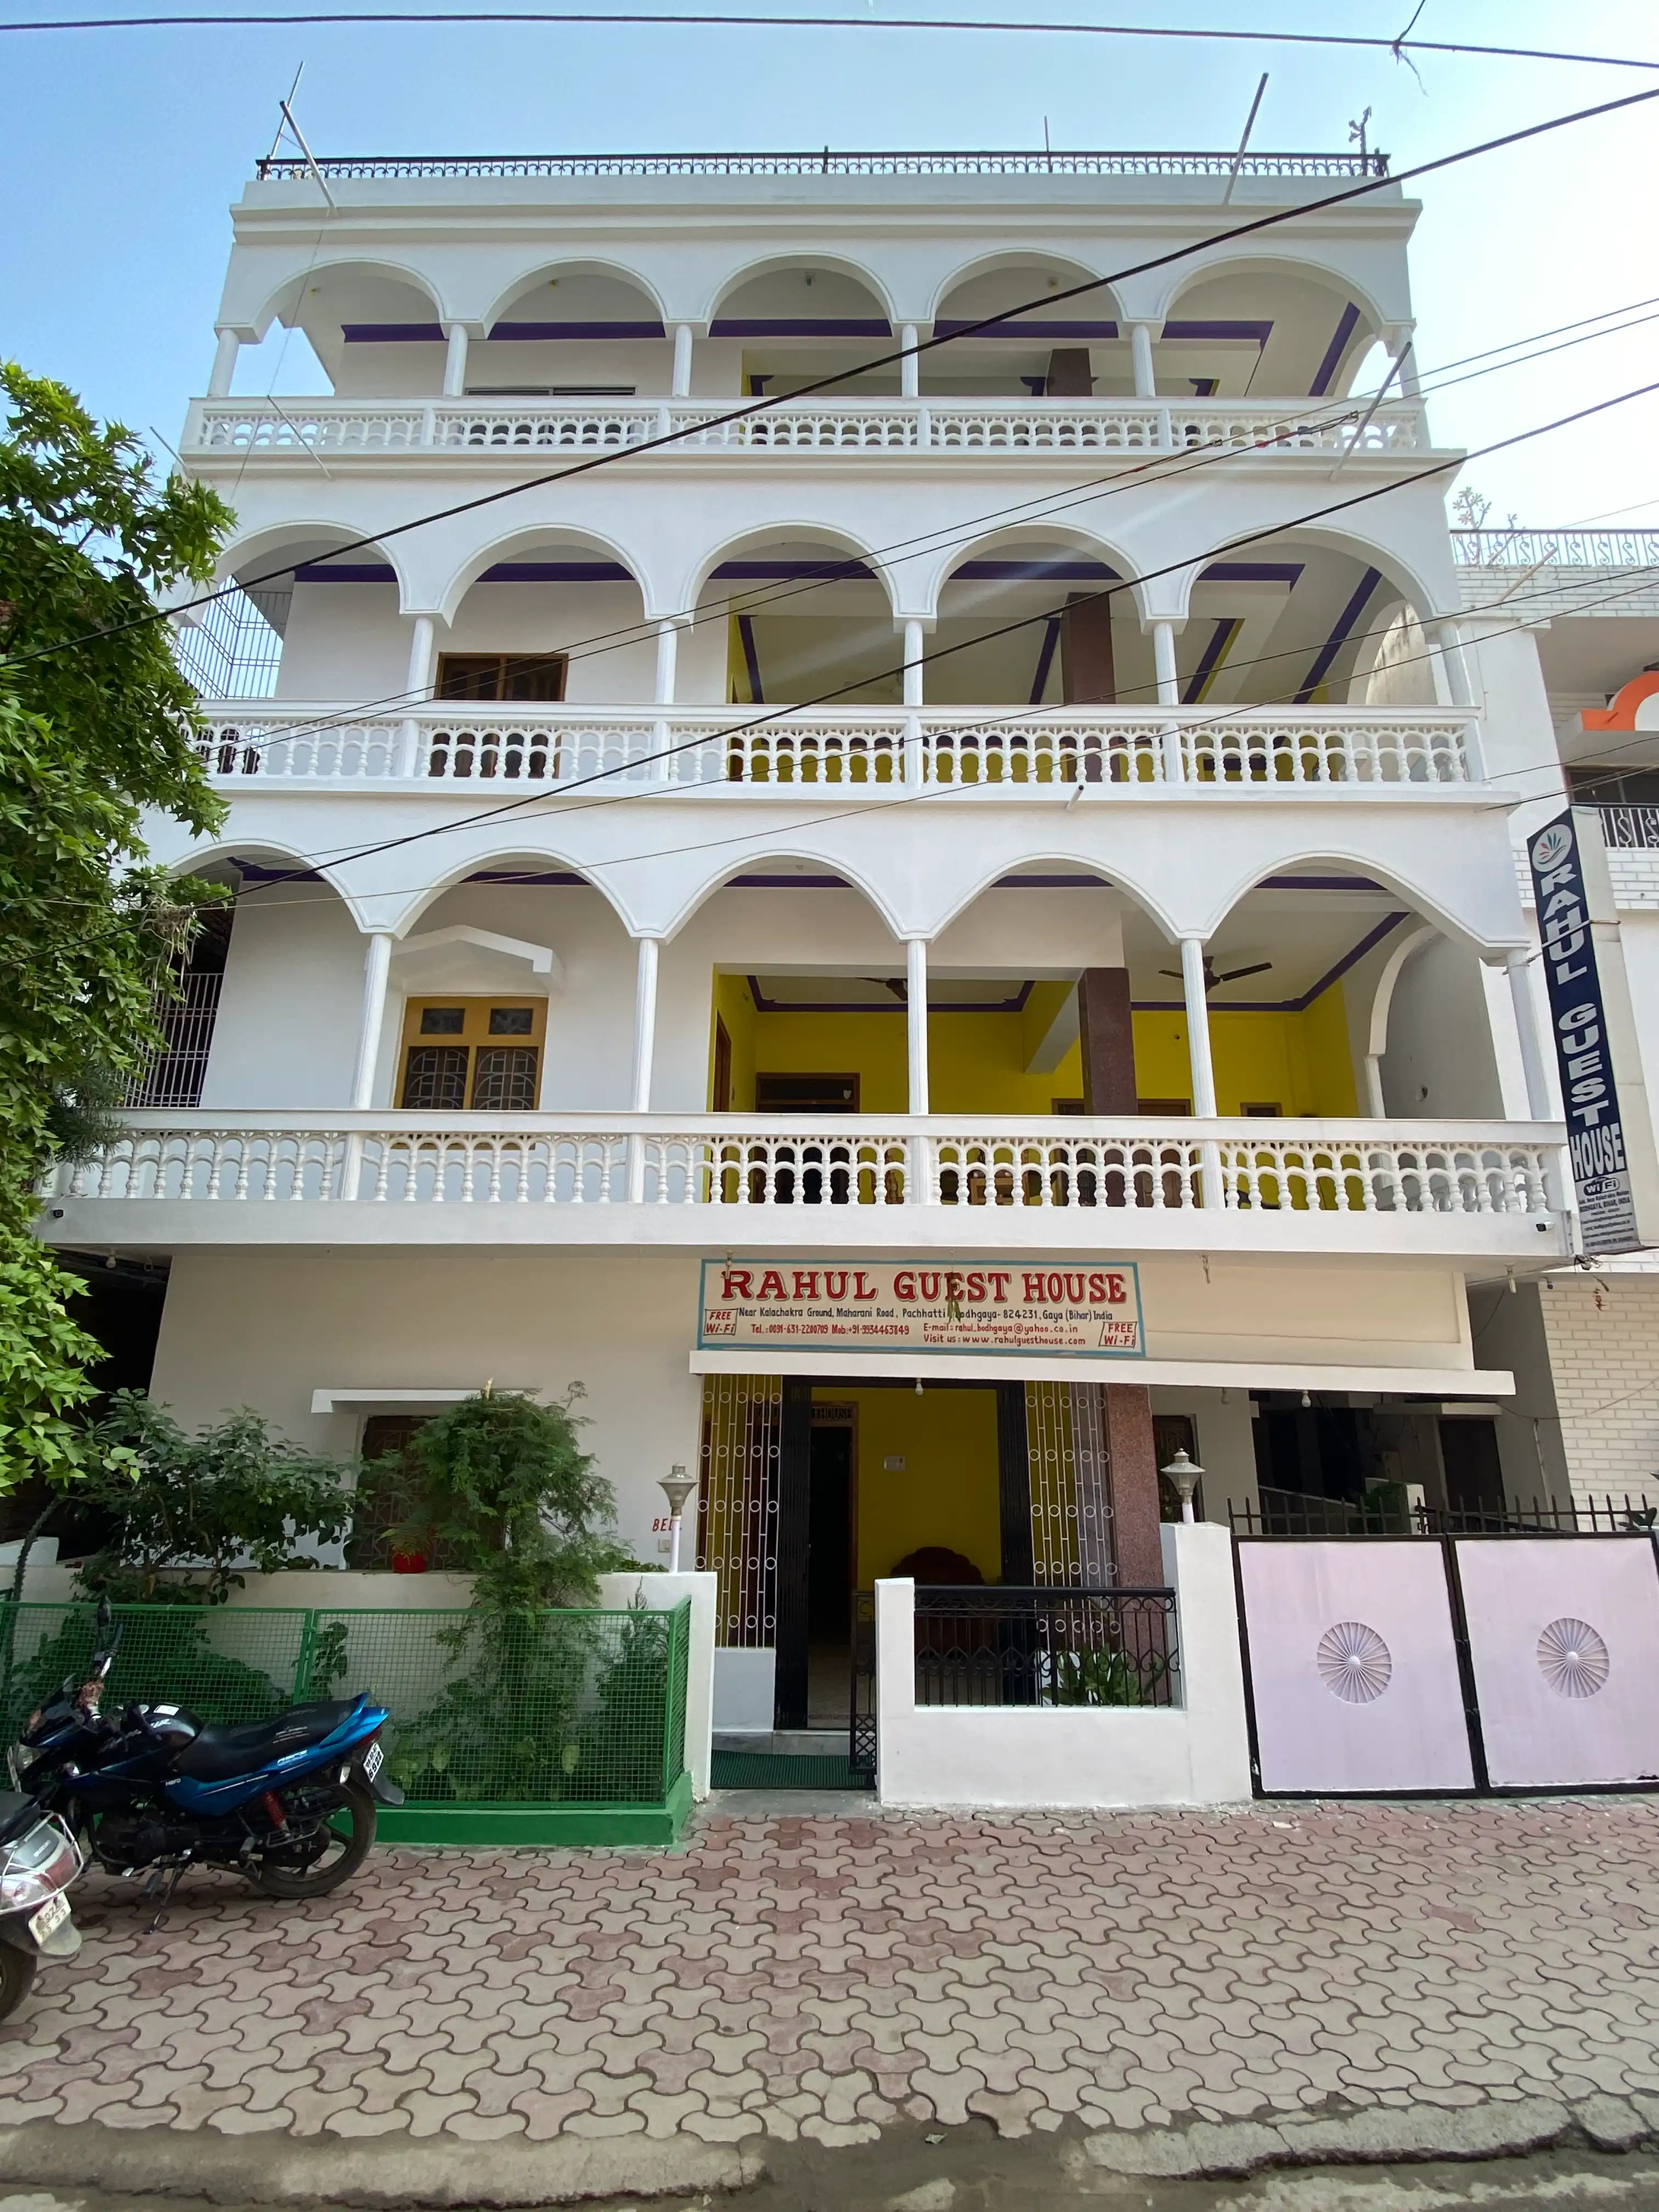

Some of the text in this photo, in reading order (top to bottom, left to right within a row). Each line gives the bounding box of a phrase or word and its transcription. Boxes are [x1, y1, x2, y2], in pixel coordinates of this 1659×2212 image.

[1541, 863, 1587, 986] RAHUL
[1558, 1002, 1609, 1127] GUEST
[1570, 1122, 1626, 1180] HOUSE
[721, 1270, 1126, 1304] RAHUL GUEST HOUSE
[709, 1311, 732, 1321] FREE
[739, 1307, 757, 1317] Near
[759, 1306, 803, 1317] Kalachakra
[836, 1307, 873, 1317] Maharani
[902, 1308, 946, 1319] Pachhatti
[953, 1308, 1001, 1322] odhgaya-
[1042, 1310, 1063, 1323] Gaya
[1065, 1308, 1092, 1323] (Bihar)
[1093, 1310, 1113, 1321] India
[706, 1323, 736, 1334] Wi-Fi
[1108, 1323, 1133, 1333] FREE
[923, 1334, 944, 1343] Visit
[1104, 1334, 1136, 1346] Wi-Fi
[652, 1517, 682, 1532] BEL
